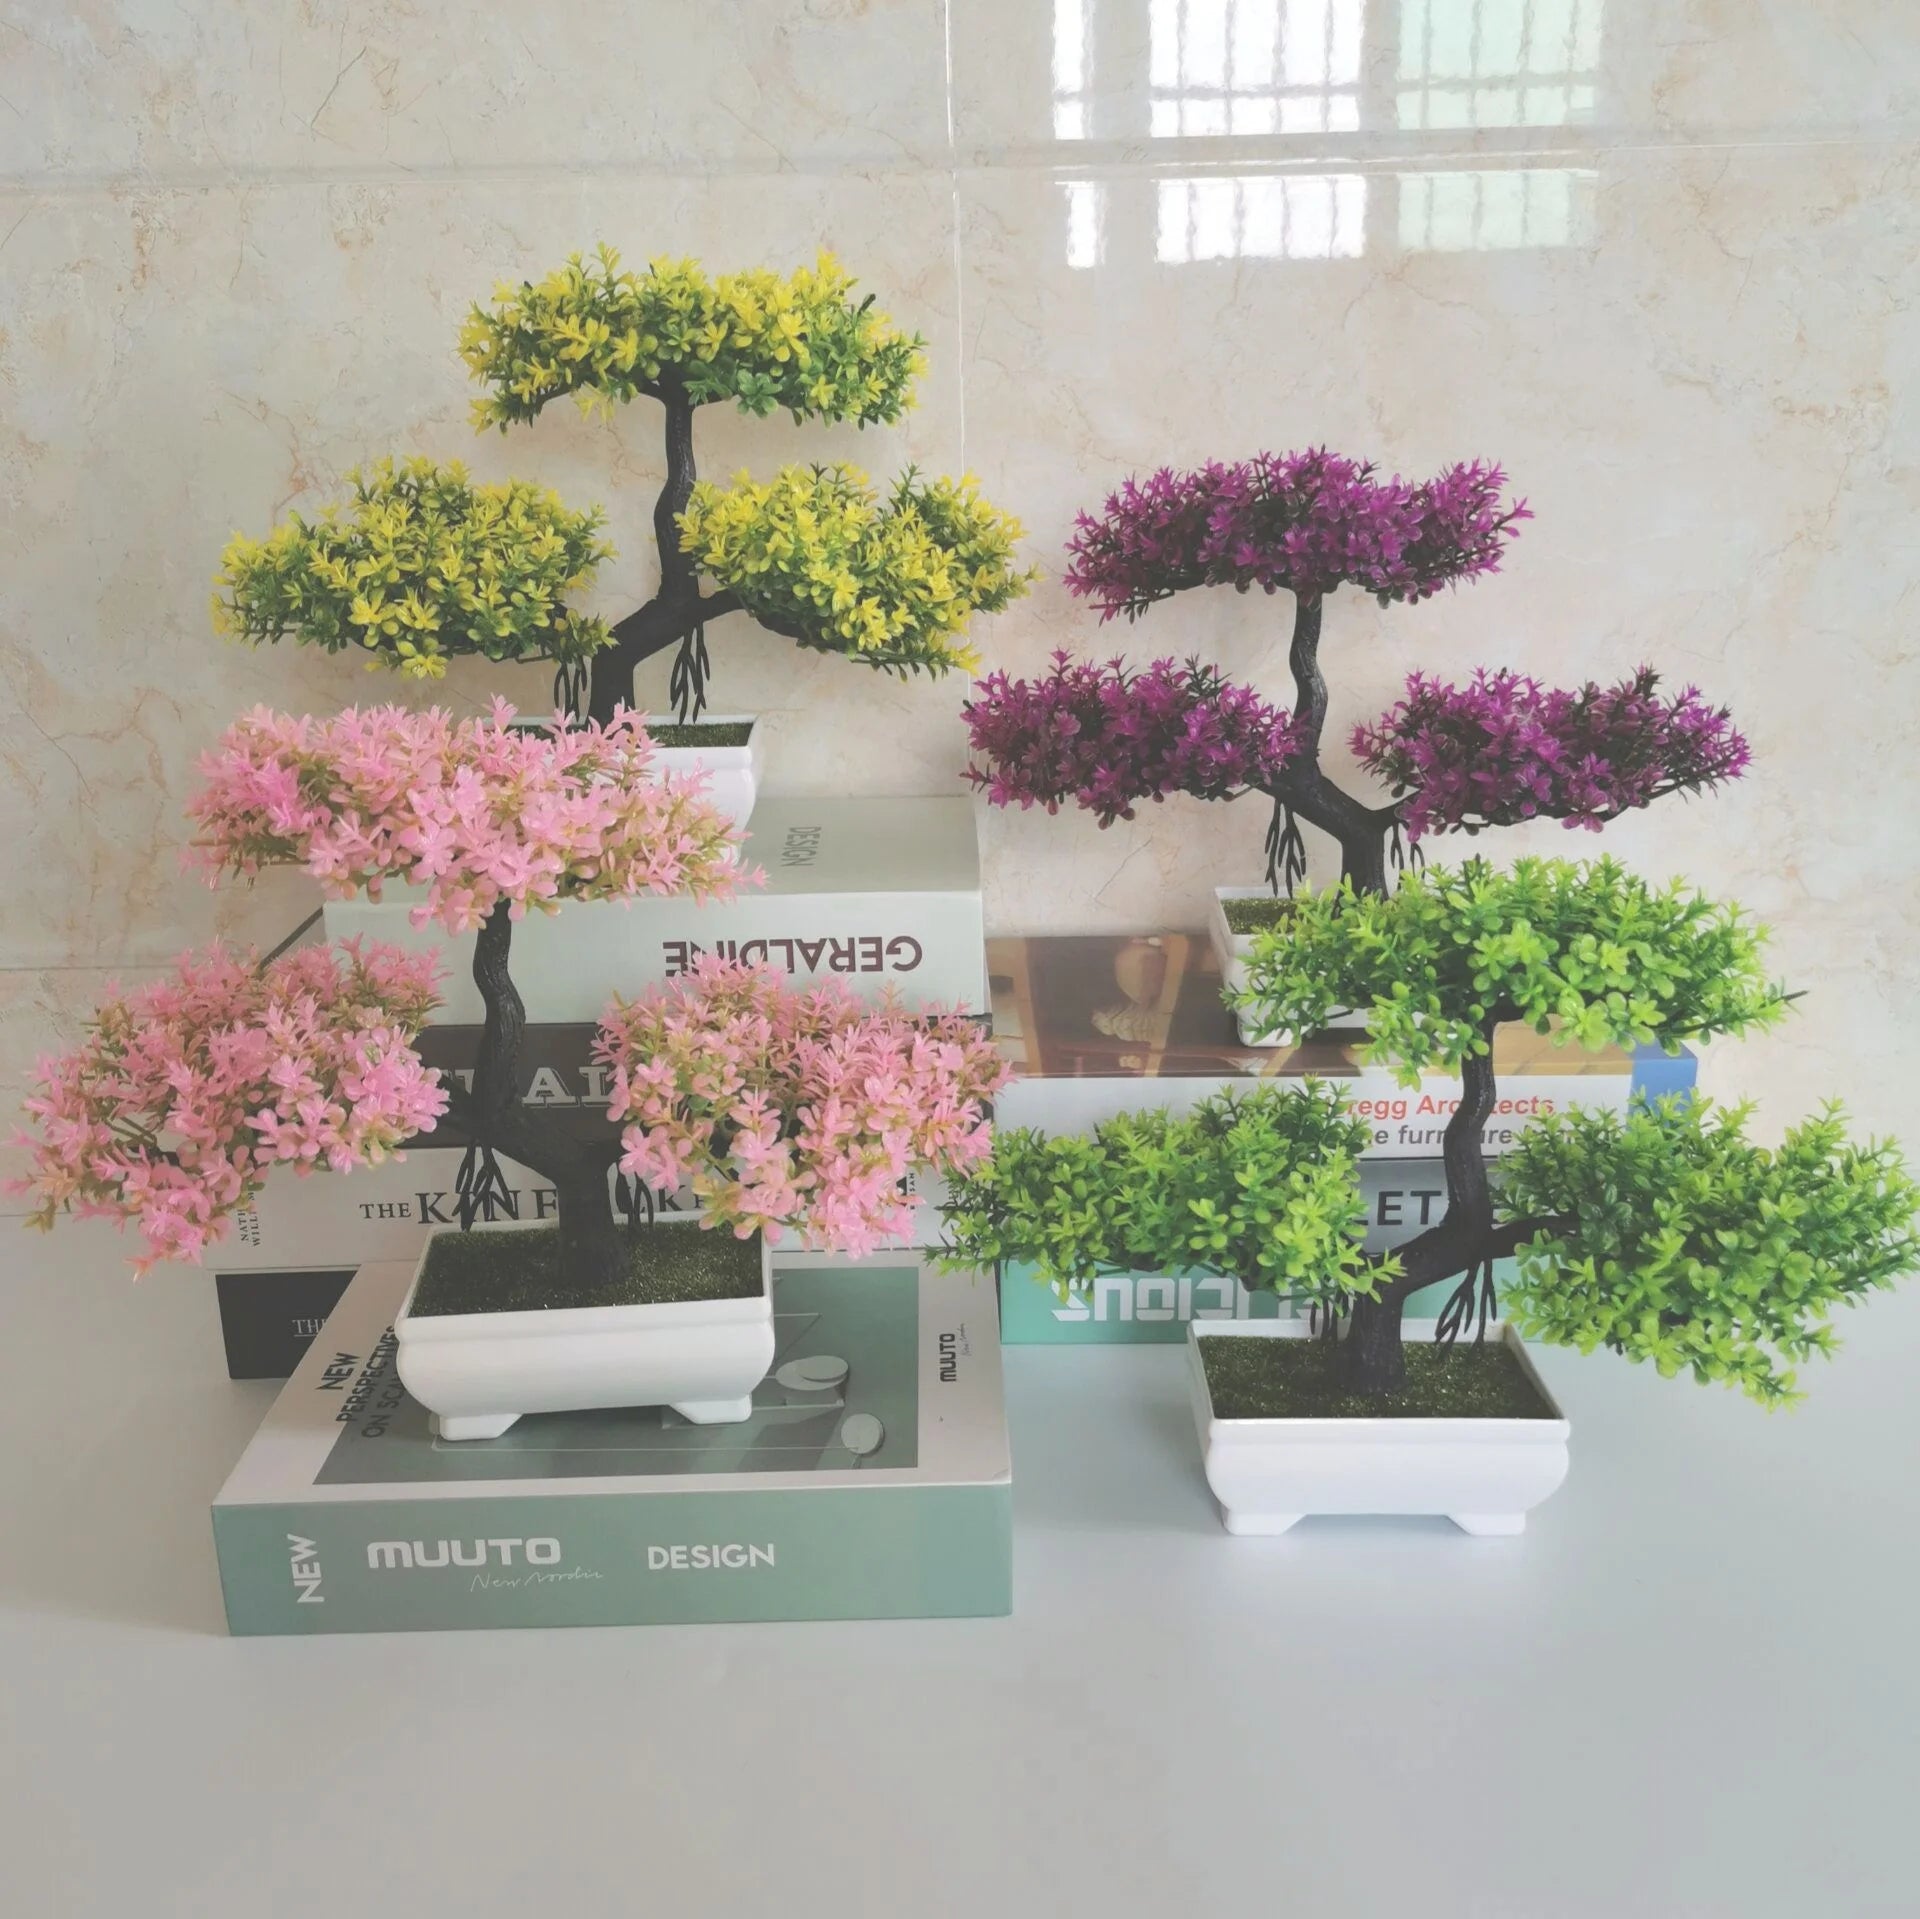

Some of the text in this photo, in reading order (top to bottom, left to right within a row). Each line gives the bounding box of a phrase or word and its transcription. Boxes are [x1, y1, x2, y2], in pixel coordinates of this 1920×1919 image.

[780, 826, 821, 867] DESIGN
[1347, 1094, 1556, 1120] regg Arcects
[359, 1202, 411, 1219] THE
[292, 1318, 327, 1334] TH
[315, 1352, 360, 1391] NEW
[939, 1333, 957, 1382] MUUTO
[361, 1414, 393, 1438] ON
[367, 1537, 562, 1568] MUUTO
[647, 1543, 776, 1570] DESIGN
[287, 1533, 325, 1603] NEW
